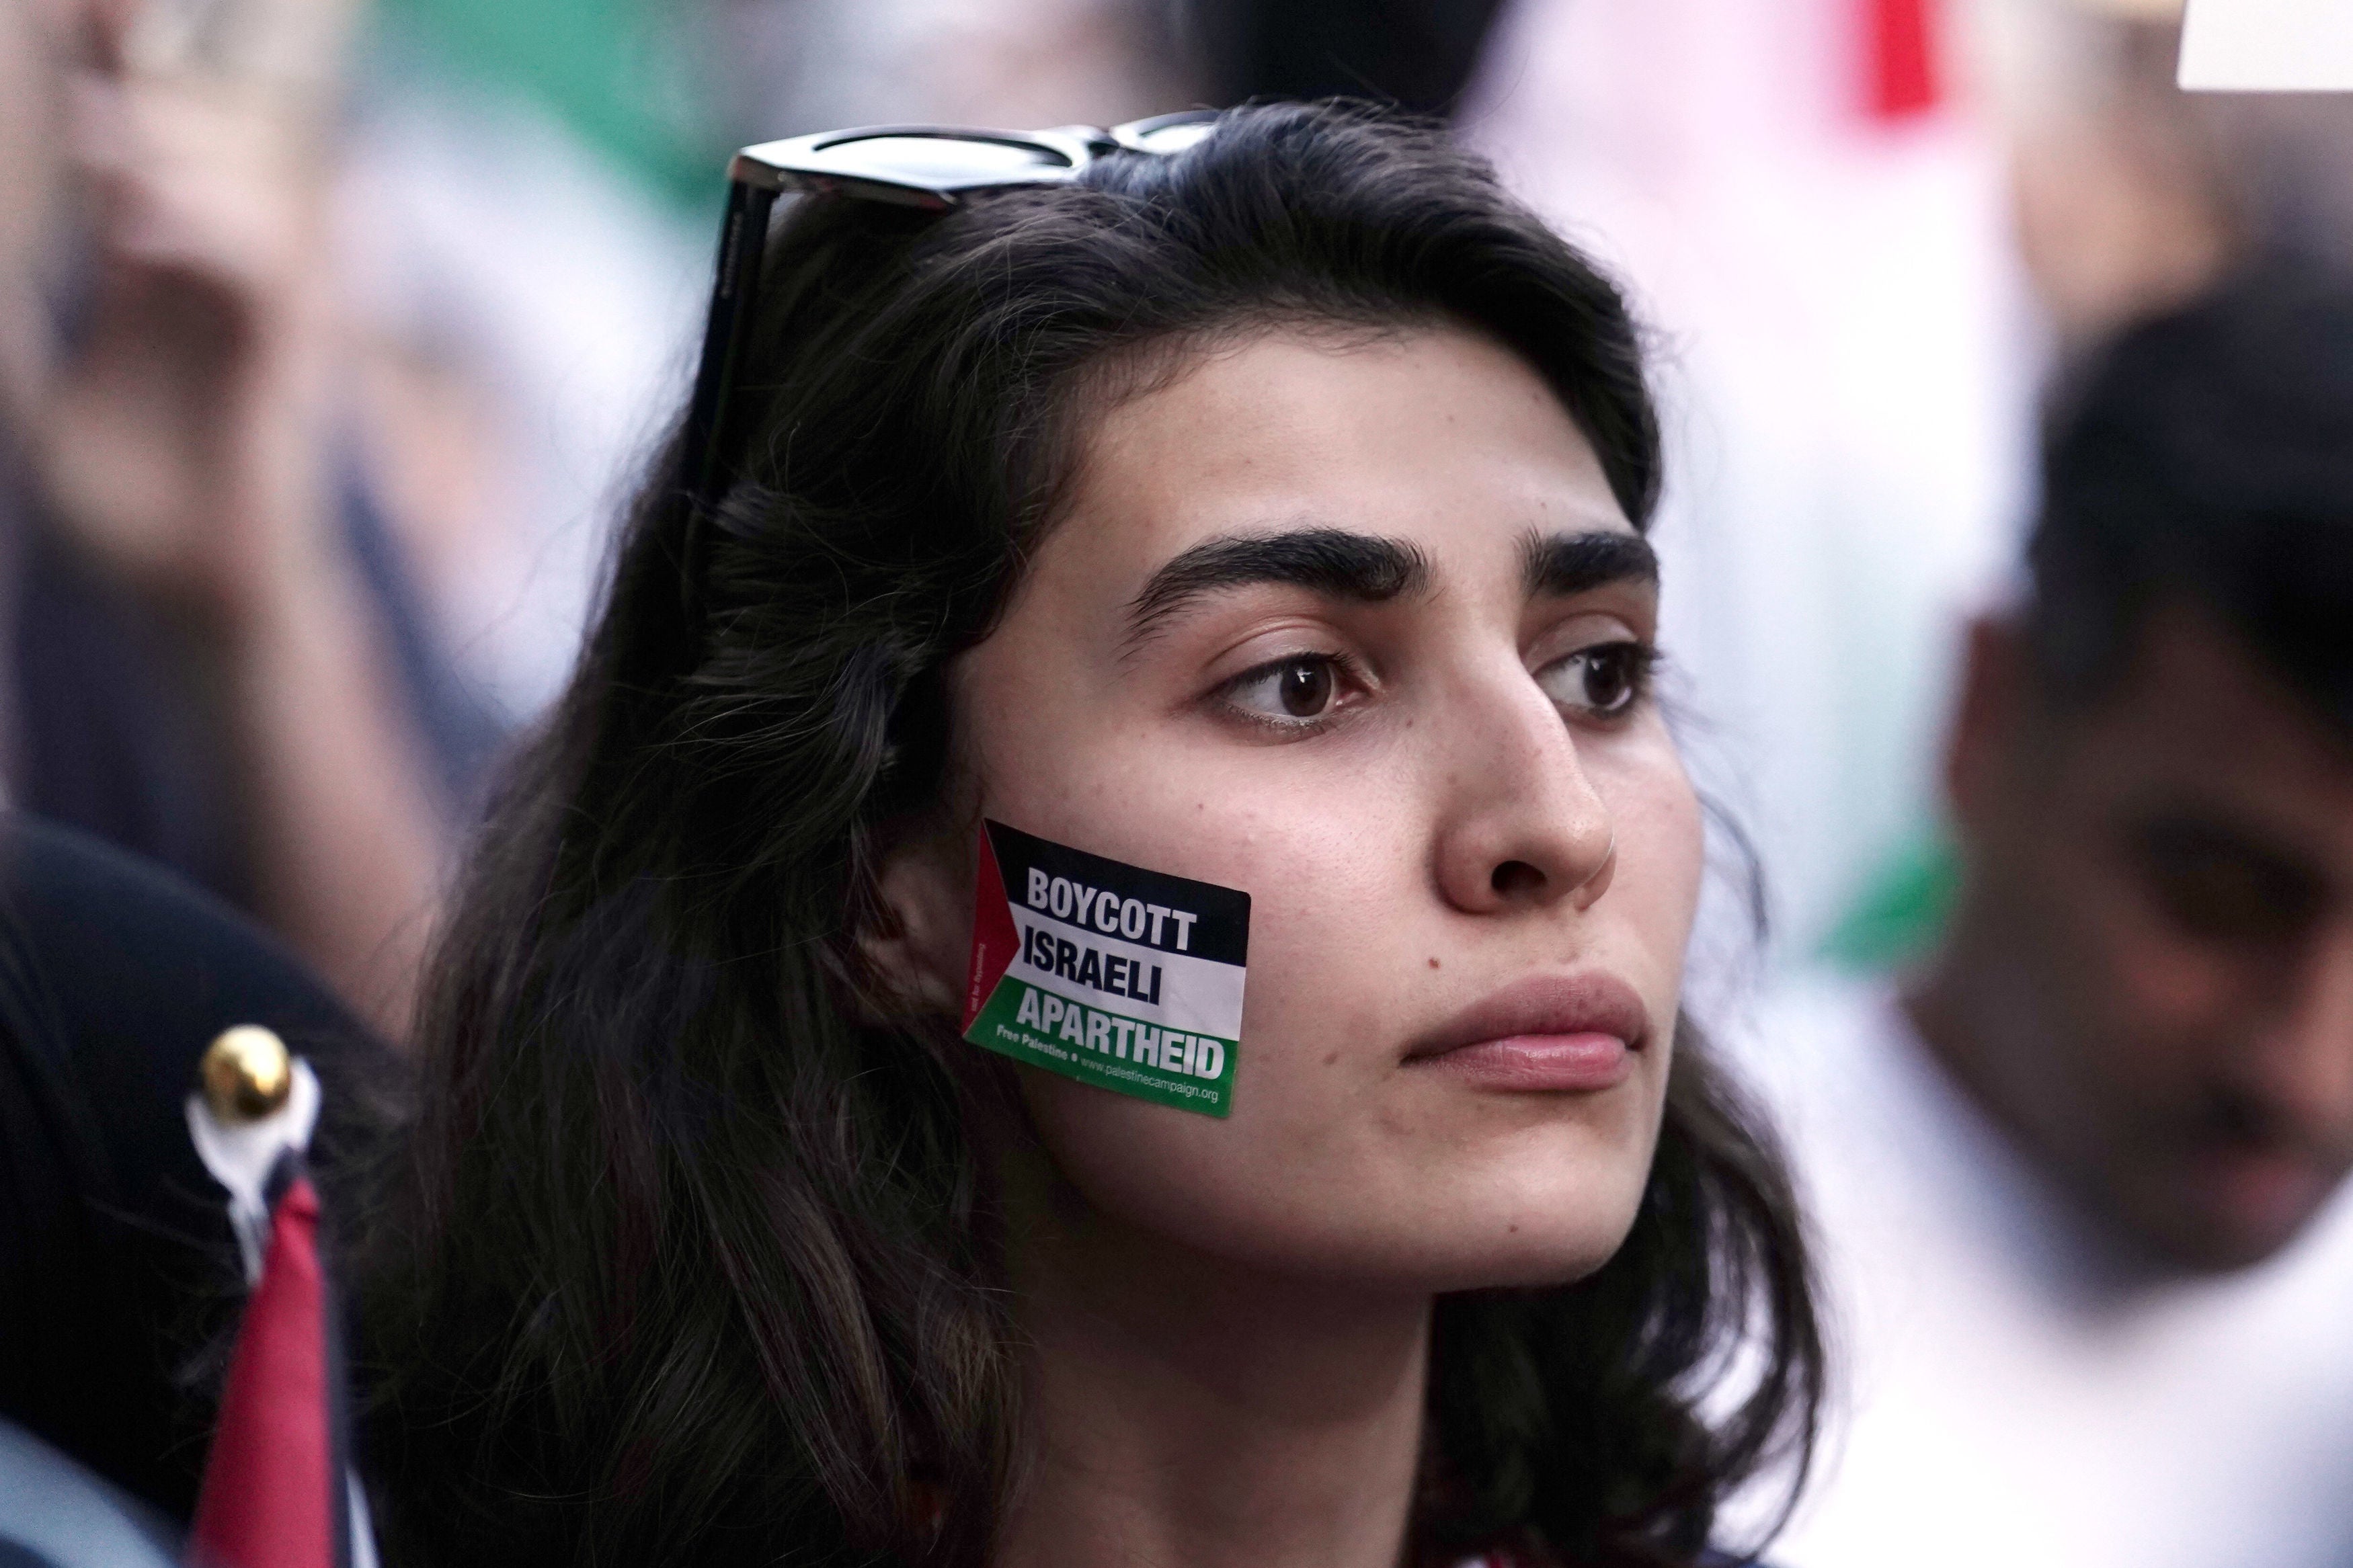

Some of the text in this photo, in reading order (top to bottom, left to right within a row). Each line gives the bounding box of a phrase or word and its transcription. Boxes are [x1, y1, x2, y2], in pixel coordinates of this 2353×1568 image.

[1027, 867, 1197, 950] BOYCOTT
[1023, 926, 1162, 1005] ISRAELI
[996, 1024, 1219, 1103] Free Palestine www.palestinecampaign.org
[1016, 987, 1224, 1080] APARTHEID
